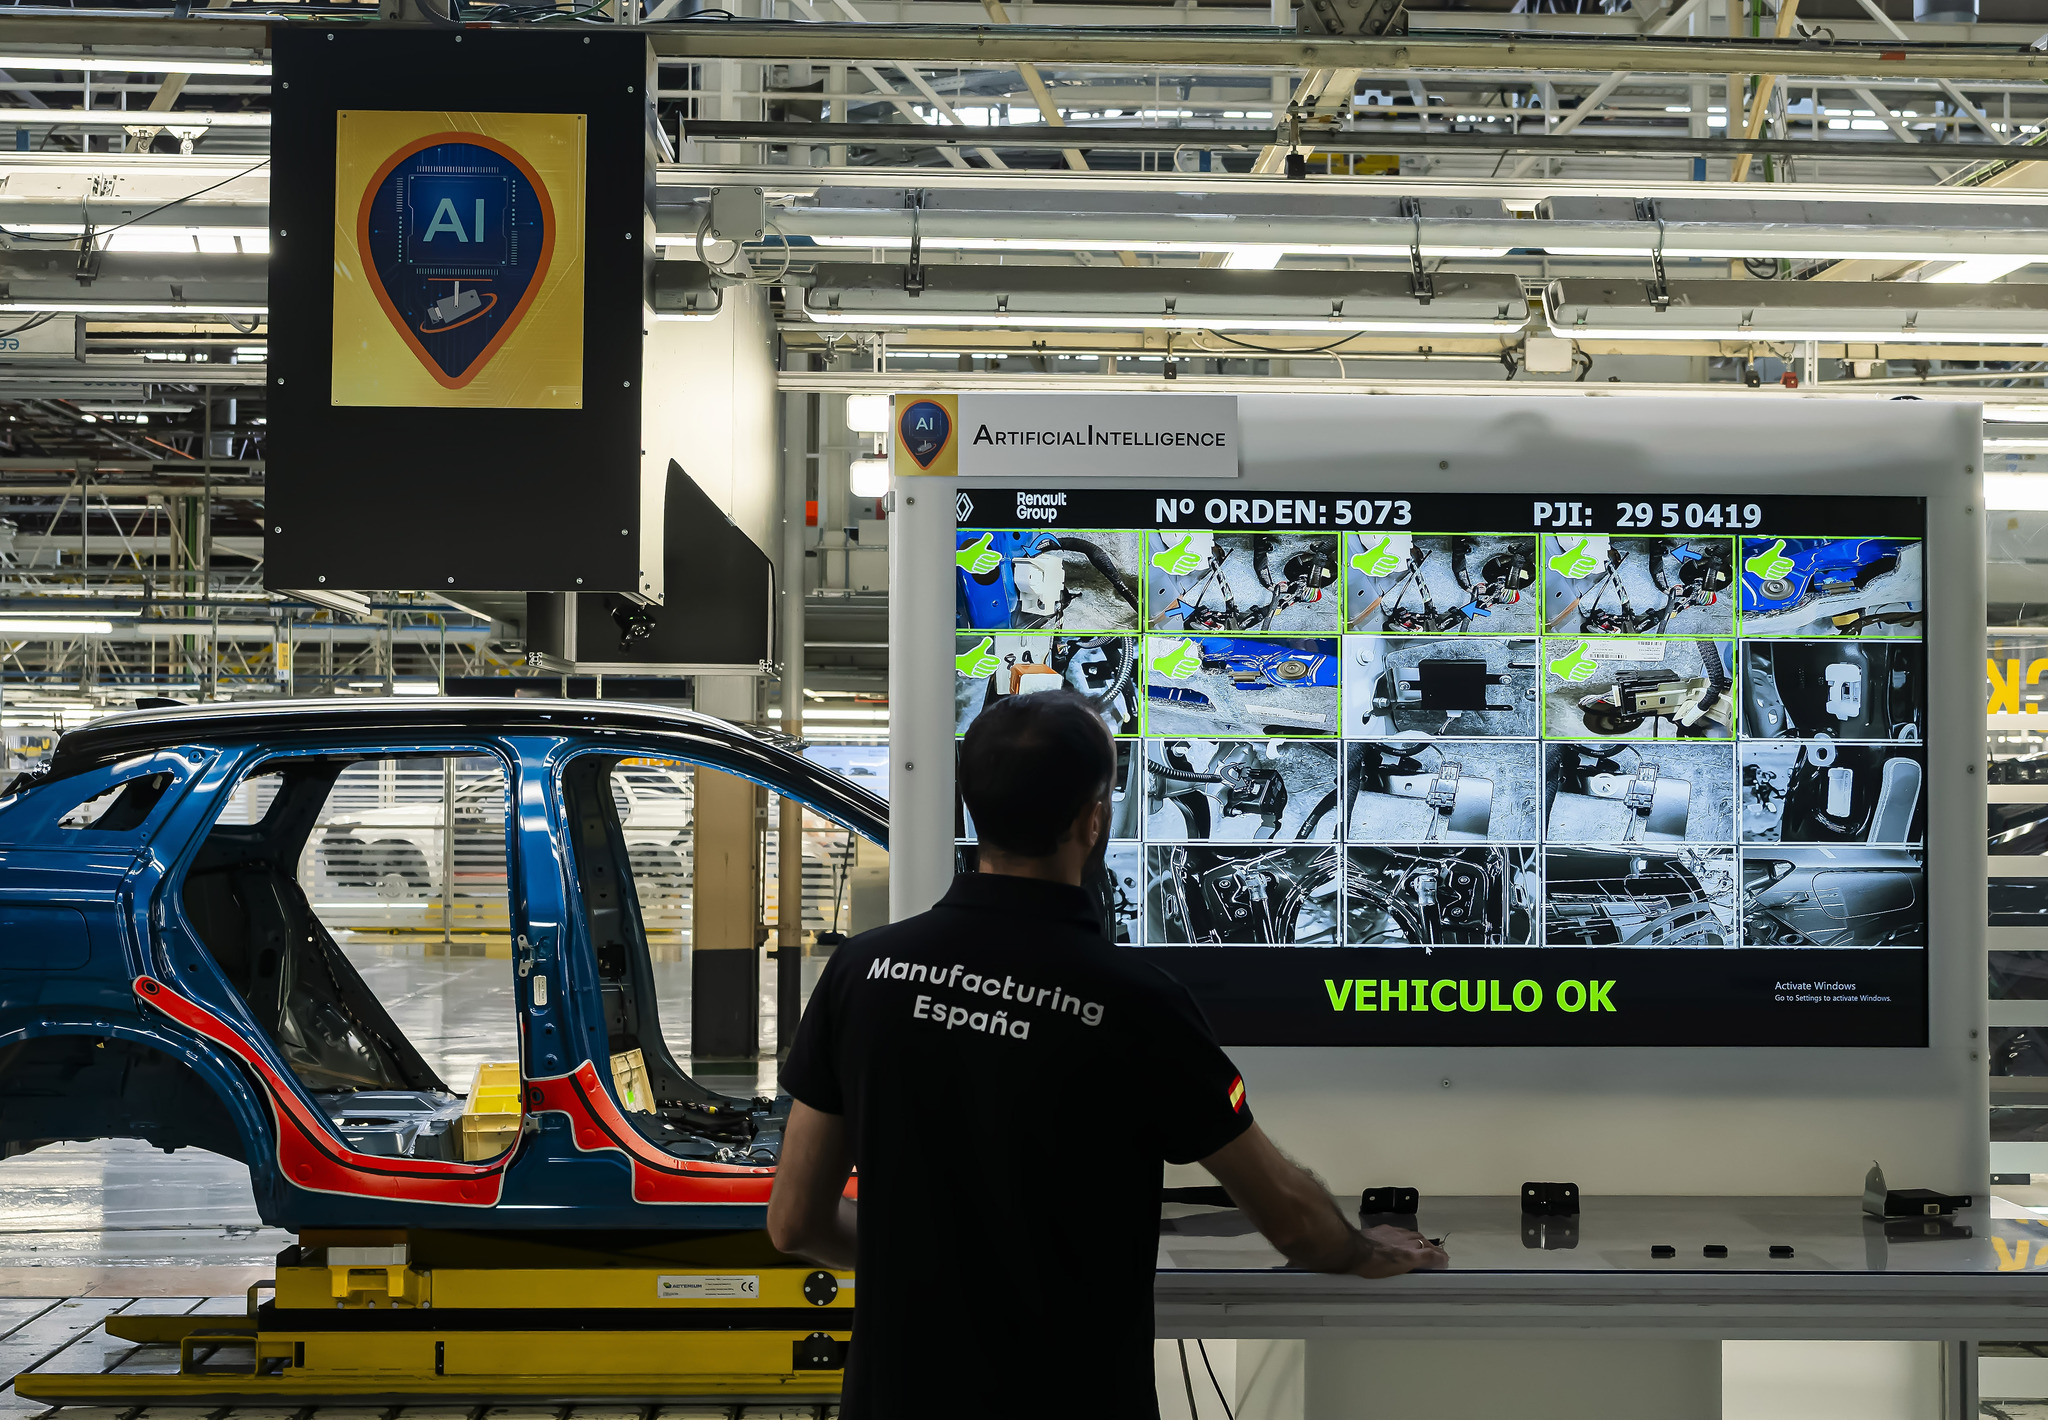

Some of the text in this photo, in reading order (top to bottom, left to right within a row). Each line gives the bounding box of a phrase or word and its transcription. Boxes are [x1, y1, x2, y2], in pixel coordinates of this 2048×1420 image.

[423, 198, 485, 243] AI
[915, 416, 934, 431] AI
[1016, 491, 1067, 506] Renault
[1016, 504, 1058, 523] Group
[1204, 499, 1327, 524] ORDEN:
[1335, 500, 1412, 525] 5073
[1533, 502, 1593, 527] PJI:
[866, 957, 1105, 1027] Manufacturing
[1324, 979, 1617, 1013] VEHICULO OK
[1774, 981, 1857, 991] Activate Windows
[1774, 994, 1785, 1002] Go
[1795, 994, 1822, 1004] Settings
[1832, 994, 1859, 1002] activate
[1859, 994, 1892, 1002] Windows.
[913, 994, 1031, 1040] España
